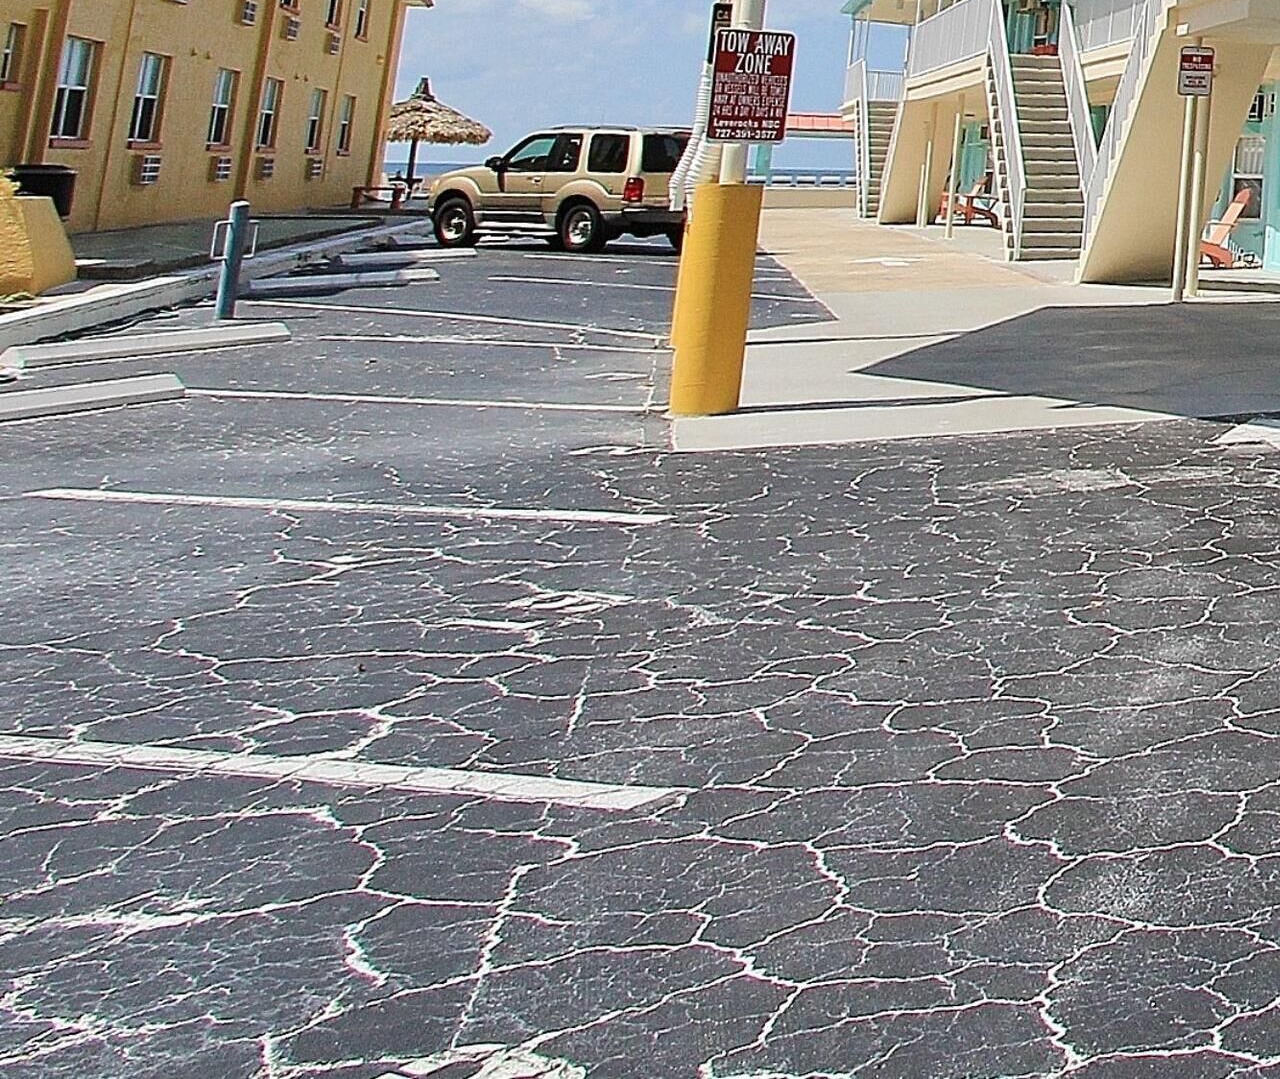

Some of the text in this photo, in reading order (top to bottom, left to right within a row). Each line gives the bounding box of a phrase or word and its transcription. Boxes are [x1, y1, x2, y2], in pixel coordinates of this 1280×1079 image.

[720, 31, 792, 56] TOW AWAY
[735, 53, 773, 75] ZONE
